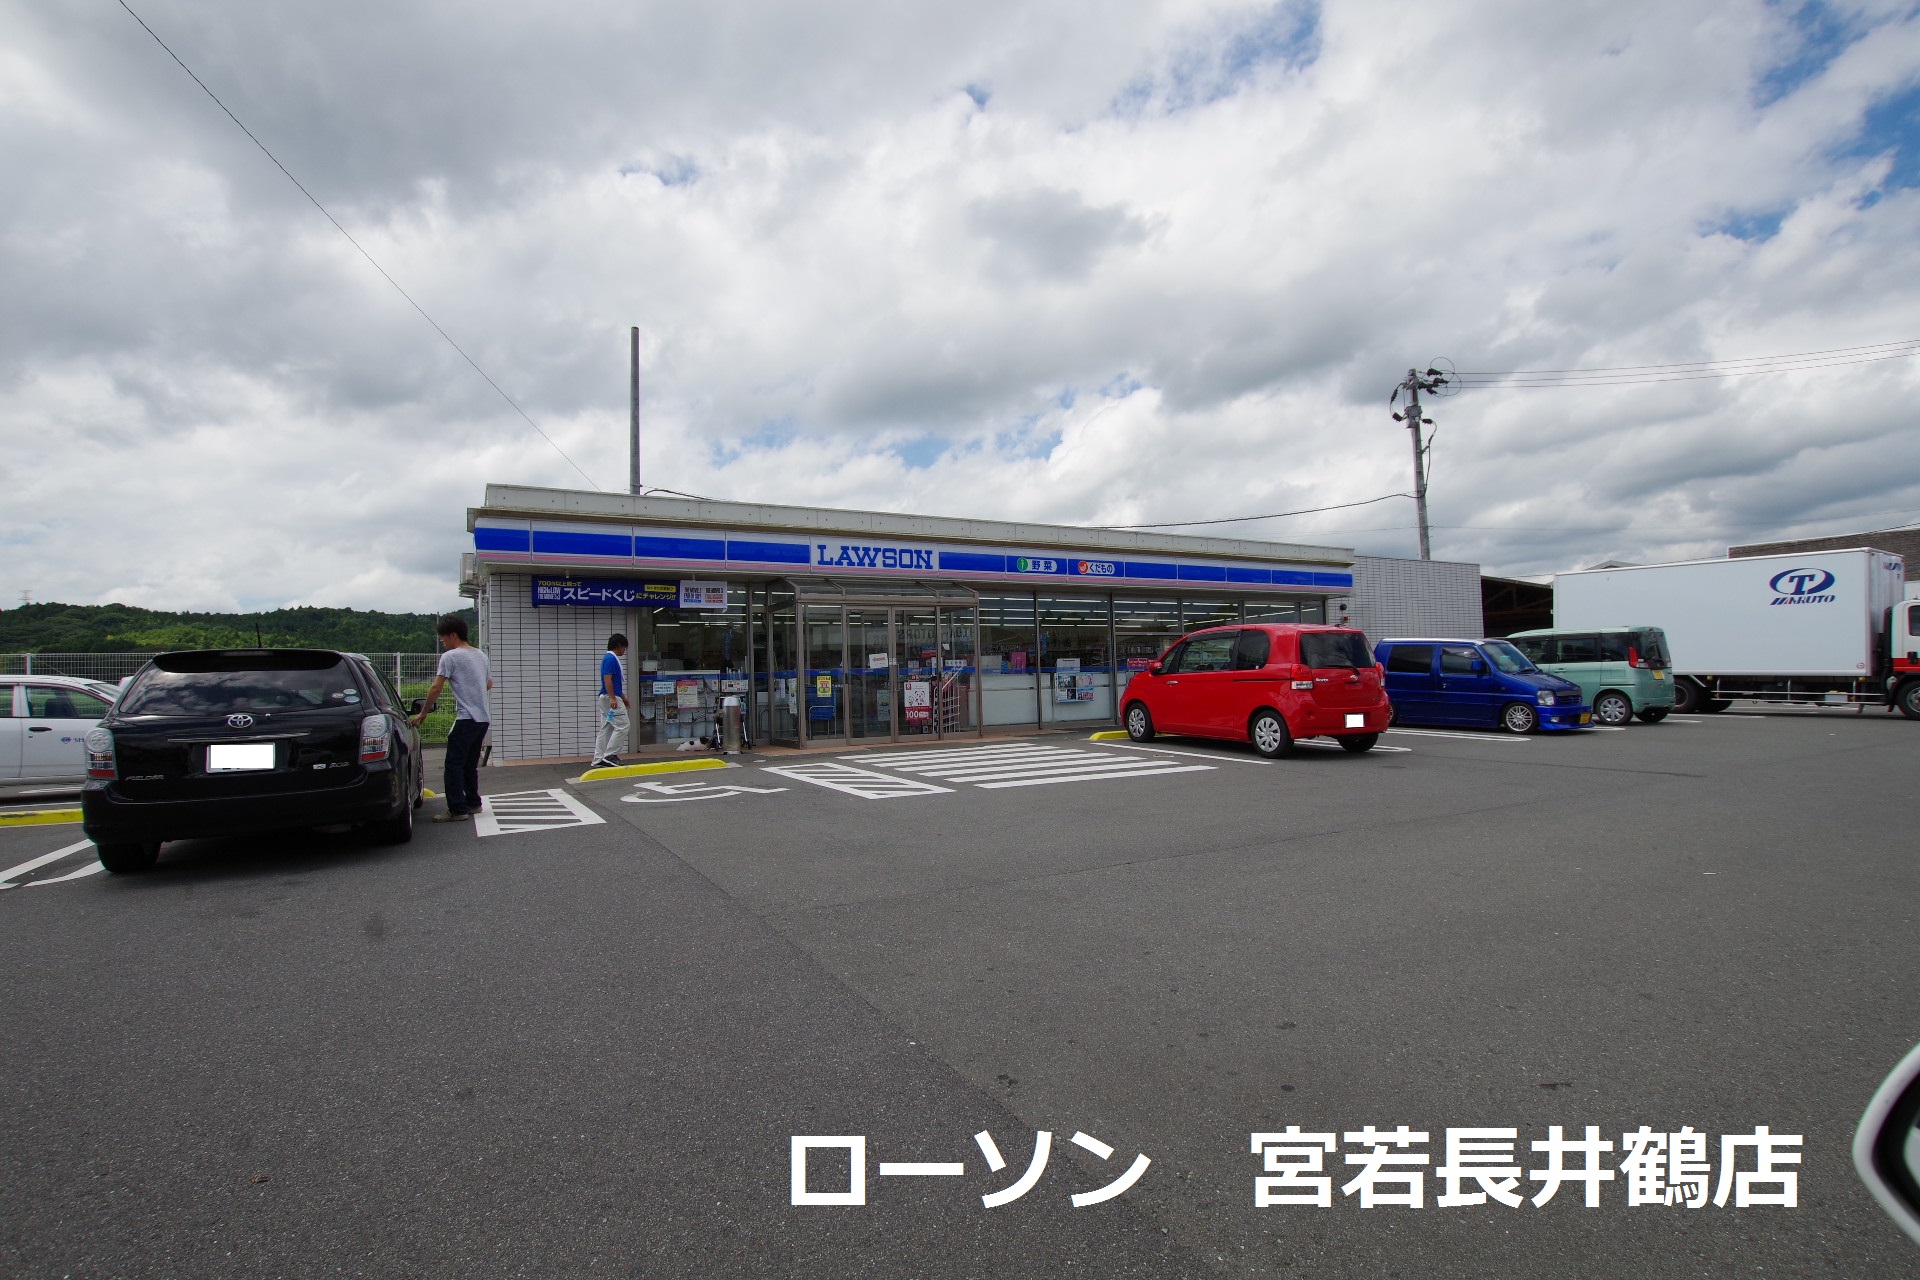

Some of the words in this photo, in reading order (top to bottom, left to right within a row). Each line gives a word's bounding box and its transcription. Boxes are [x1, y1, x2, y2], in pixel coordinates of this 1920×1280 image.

[817, 545, 933, 569] LAWSON
[1031, 560, 1053, 571] 野菜
[1089, 562, 1113, 574] くだもの
[562, 587, 635, 602] スピードくじ
[905, 710, 919, 719] 100
